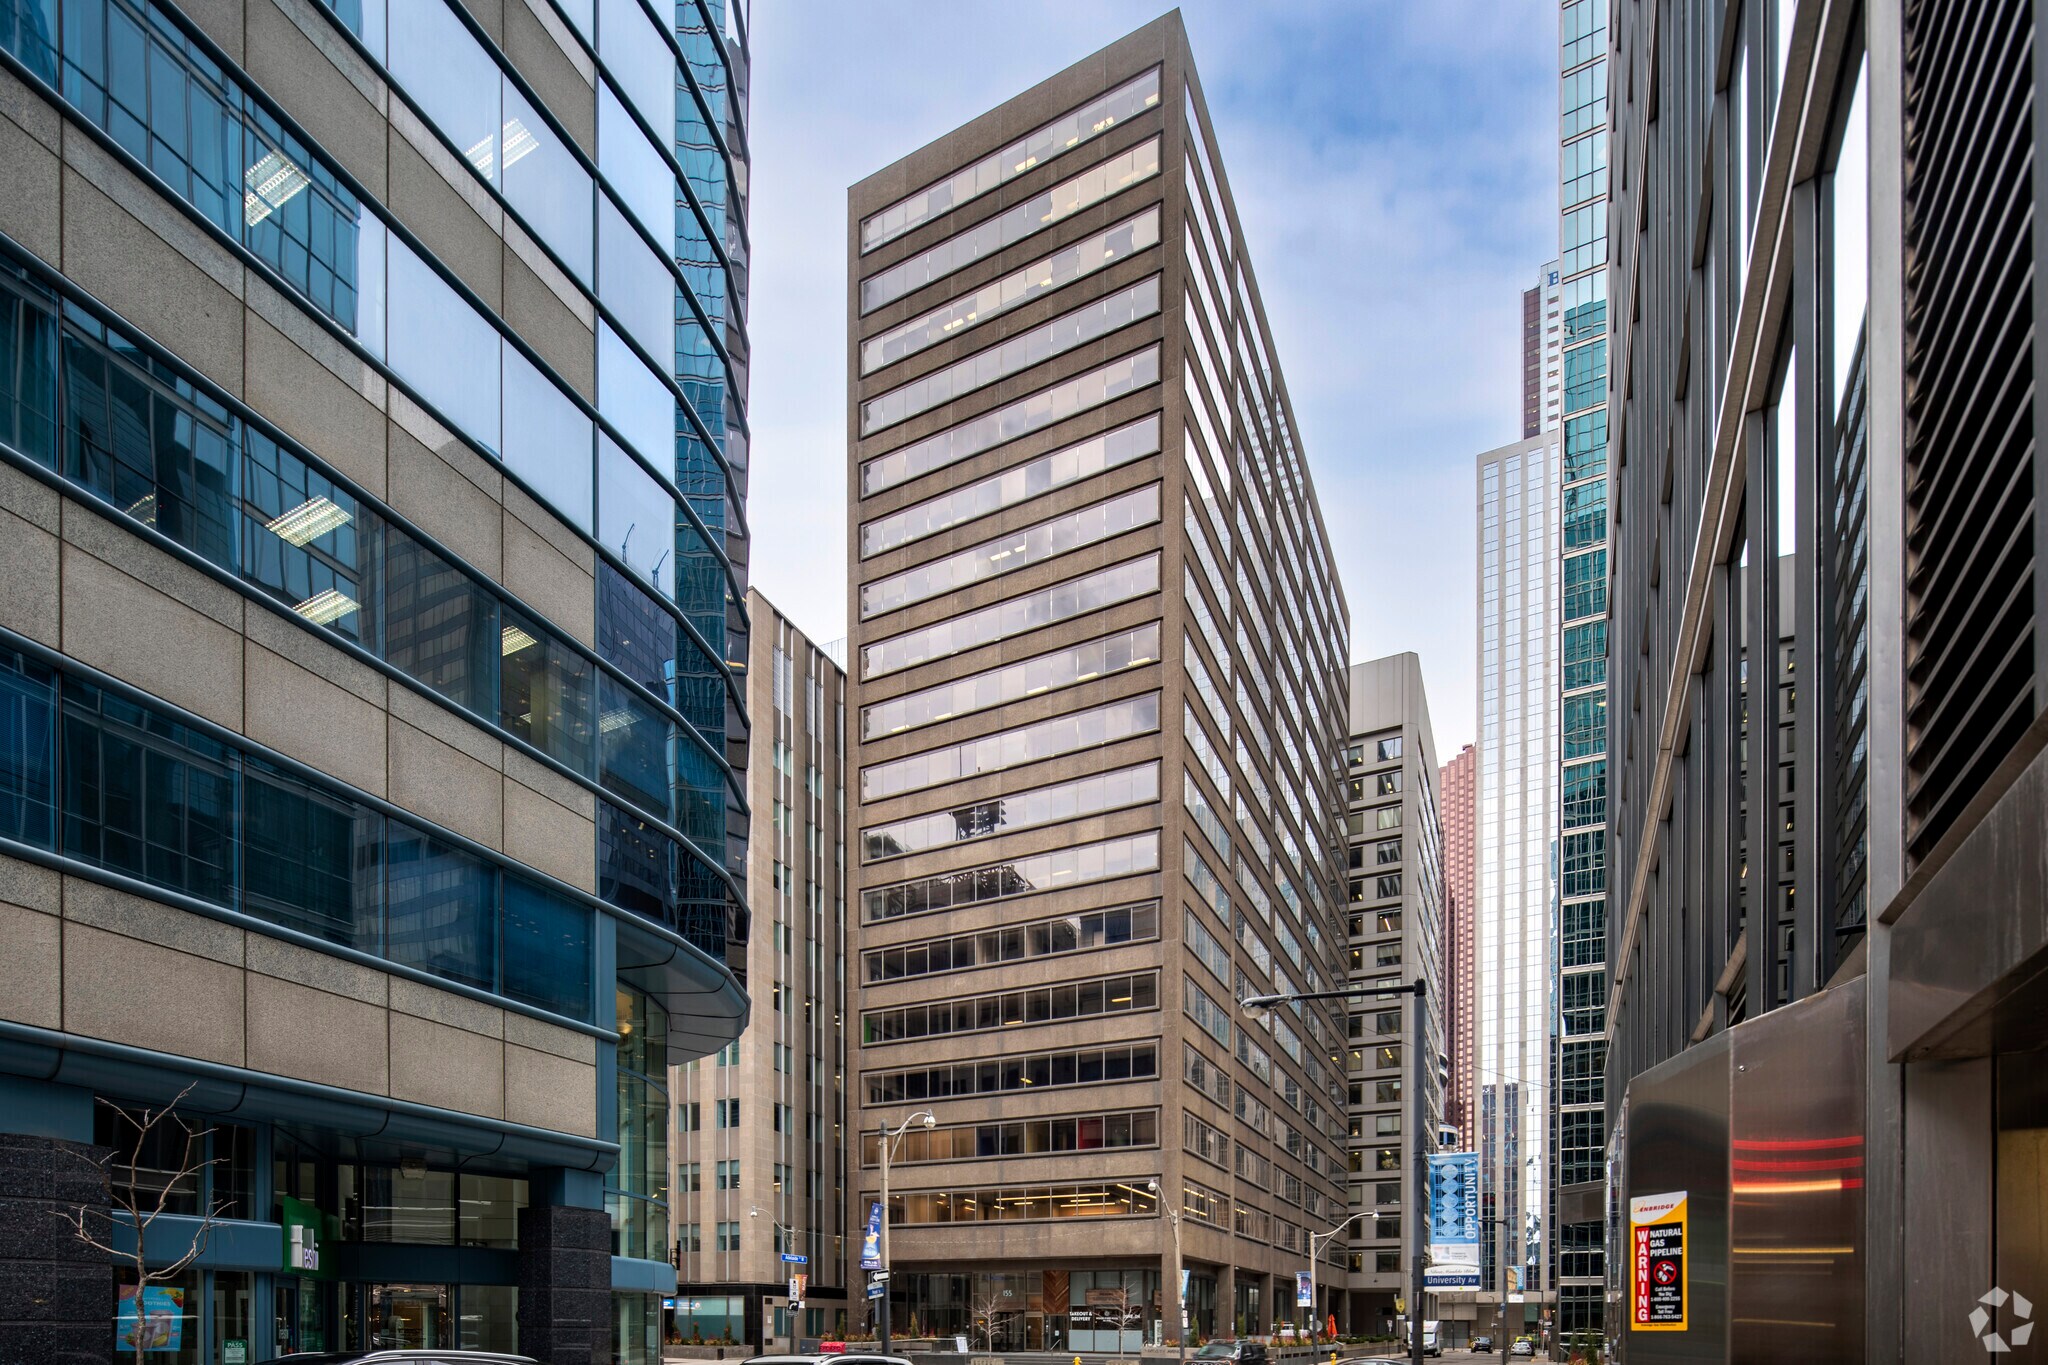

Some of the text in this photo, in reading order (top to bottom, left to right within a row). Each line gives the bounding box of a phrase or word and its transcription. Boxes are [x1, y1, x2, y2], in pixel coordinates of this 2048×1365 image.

[1465, 1159, 1476, 1239] OPPORTUNITY
[1640, 1204, 1674, 1212] ENBRIDGE
[1650, 1228, 1682, 1238] NATURAL
[1650, 1239, 1665, 1247] GAS
[1650, 1247, 1682, 1257] PIPELINE
[1637, 1230, 1648, 1321] WARNING
[1427, 1276, 1466, 1286] University
